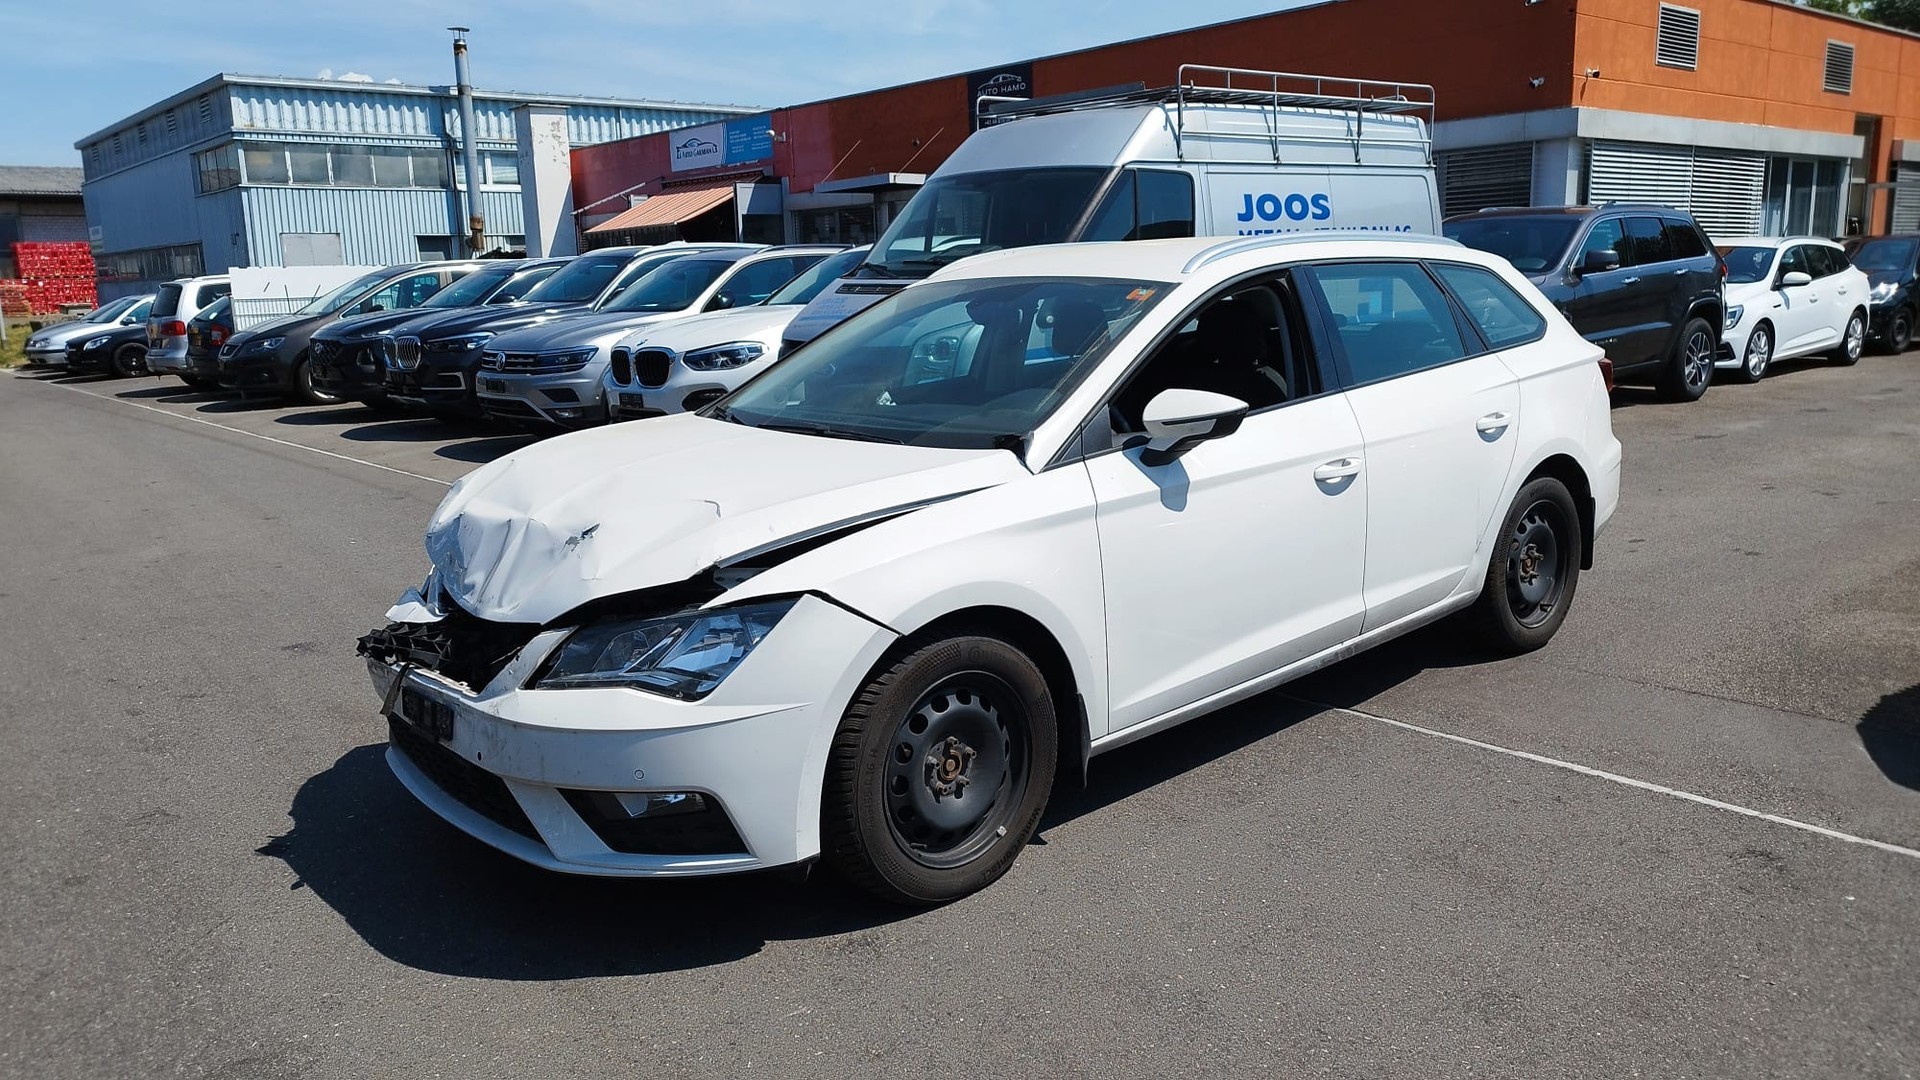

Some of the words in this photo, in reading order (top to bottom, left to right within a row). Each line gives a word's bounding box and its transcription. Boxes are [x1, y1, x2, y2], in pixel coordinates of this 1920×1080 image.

[977, 88, 998, 96] AUTO
[1001, 83, 1026, 93] HAMO
[1237, 193, 1331, 222] JOOS
